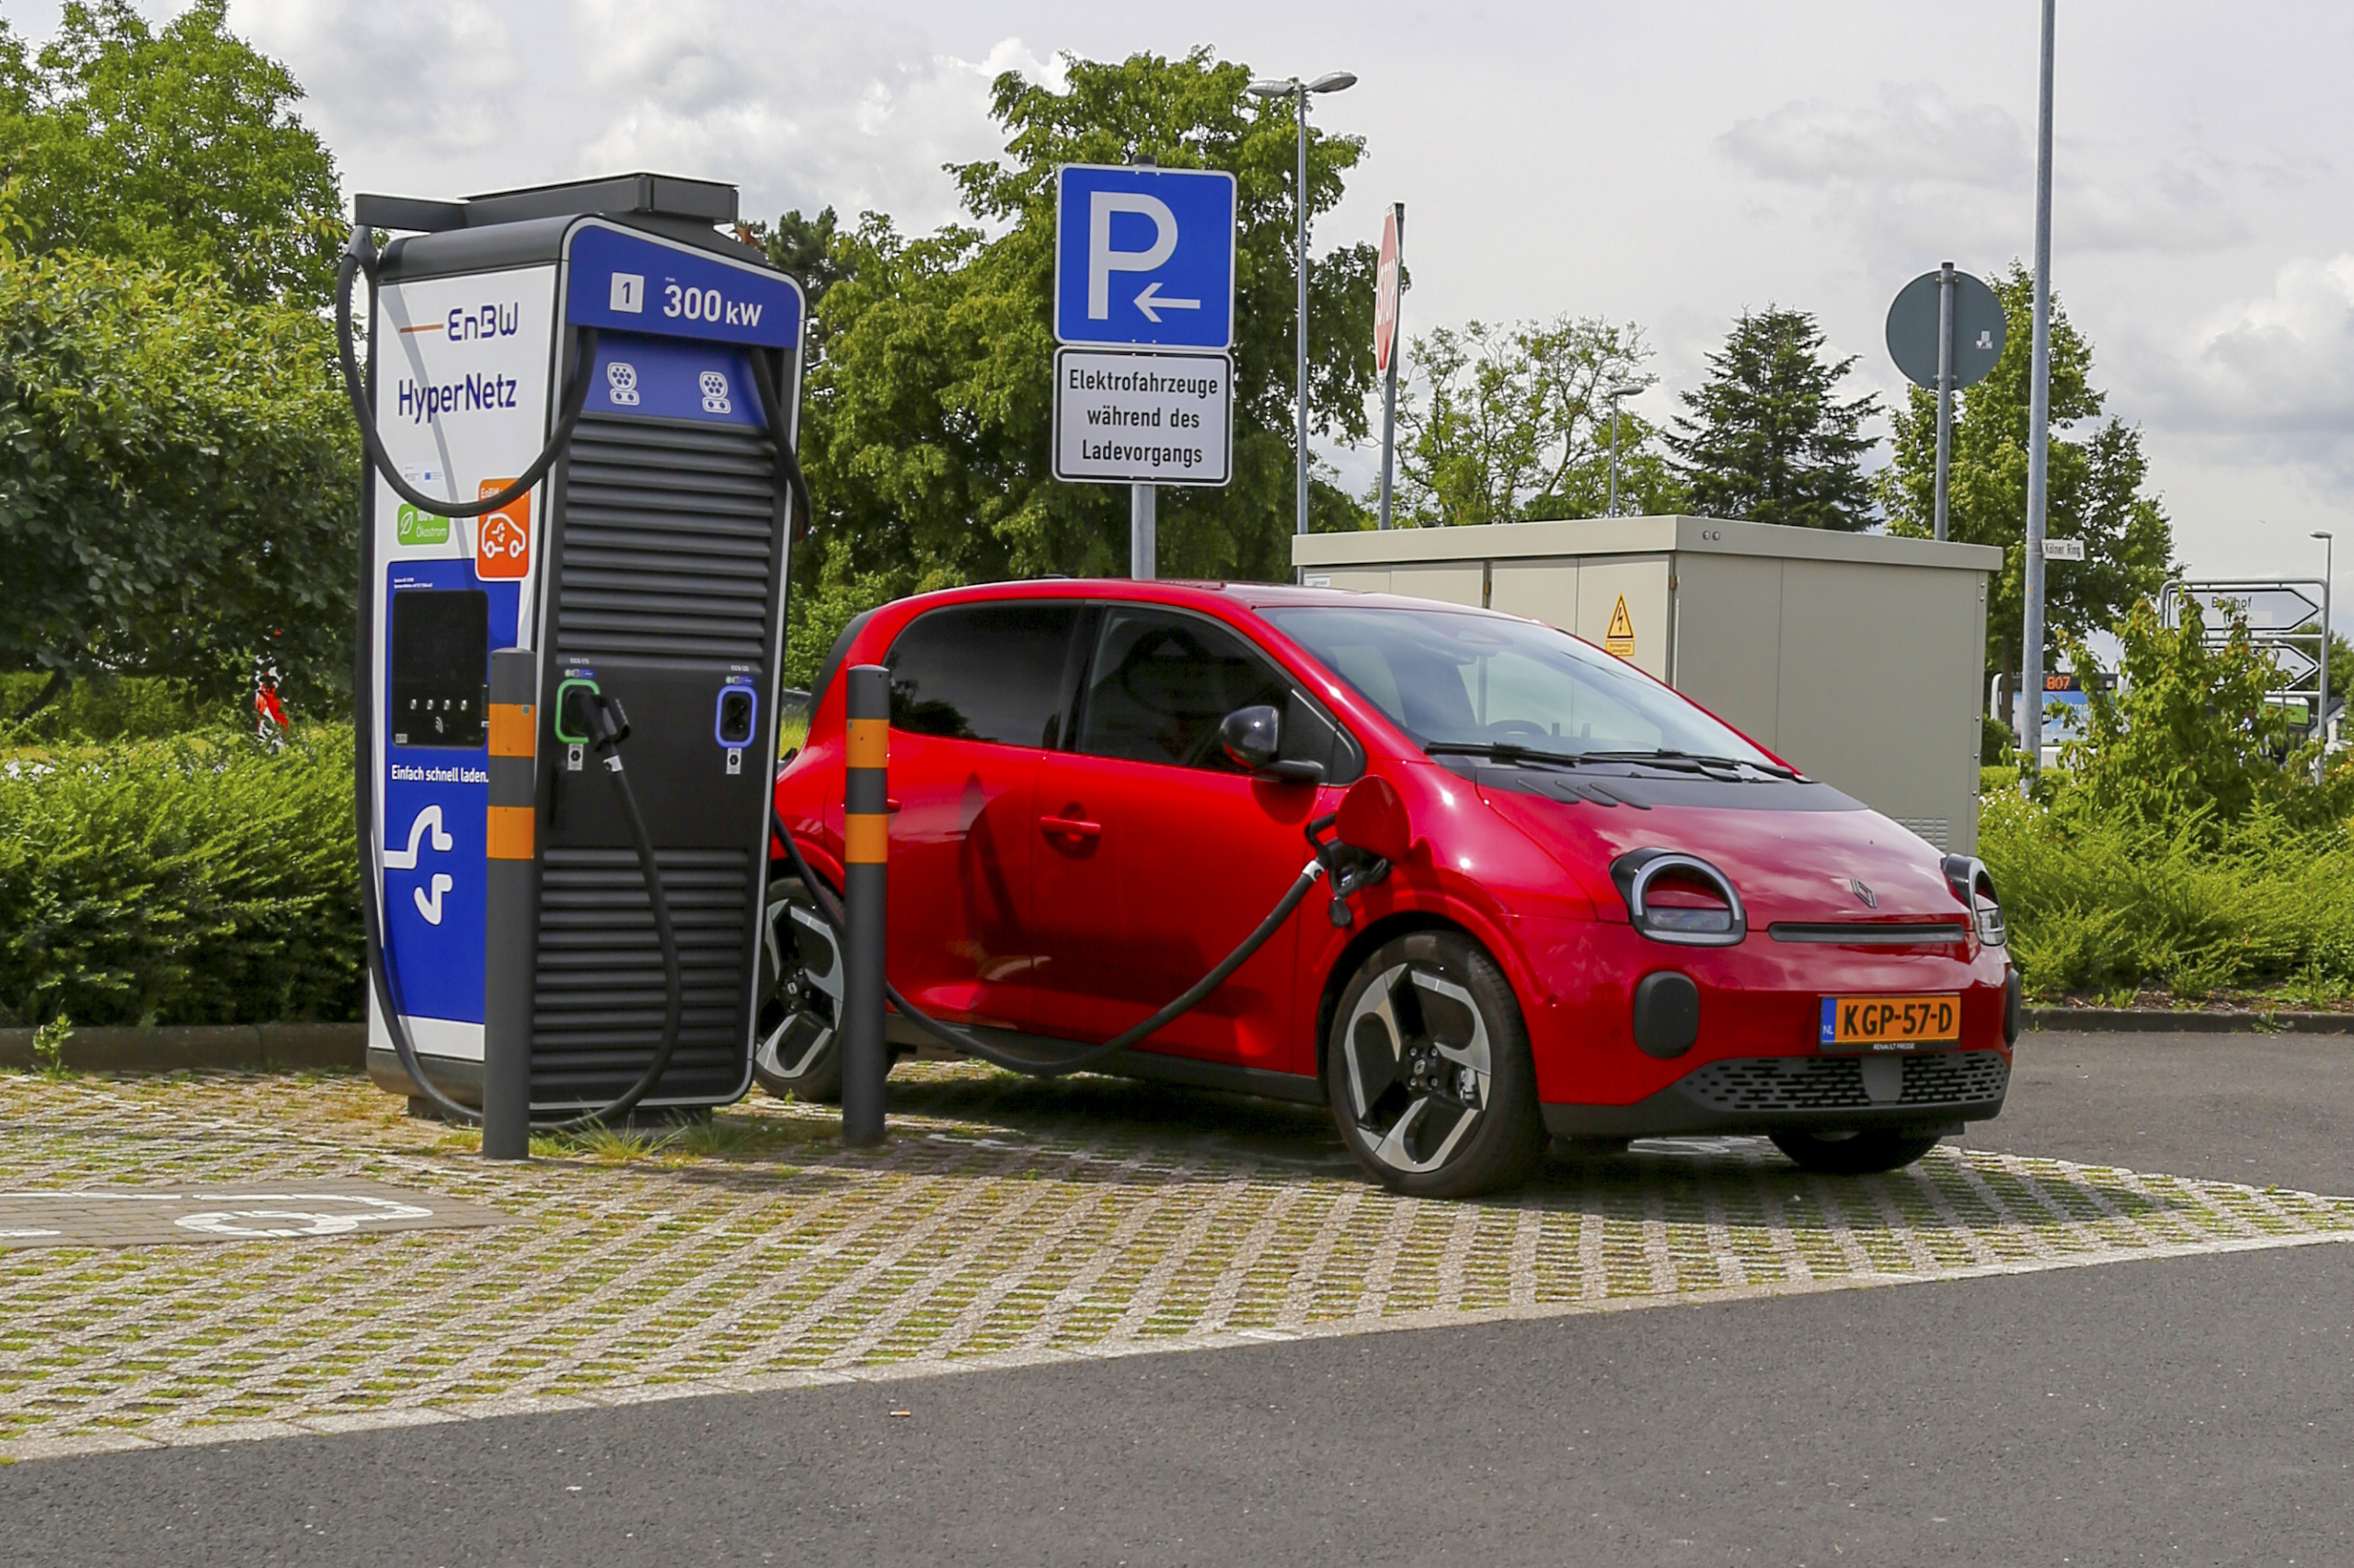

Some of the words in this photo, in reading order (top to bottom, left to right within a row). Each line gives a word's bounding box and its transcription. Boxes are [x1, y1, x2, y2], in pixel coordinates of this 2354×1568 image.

[1088, 191, 1178, 320] P
[622, 281, 631, 304] 1
[663, 284, 722, 323] 300
[725, 301, 763, 326] kW
[448, 302, 518, 341] EnBW
[398, 372, 517, 425] HyperNetz
[1069, 369, 1218, 399] Elektrofahrzeuge
[1086, 405, 1161, 427] während
[1170, 407, 1200, 429] des
[1082, 439, 1203, 468] Ladevorgangs
[2046, 676, 2071, 690] 807
[391, 764, 424, 781] Einfach
[425, 766, 459, 783] schnell
[460, 767, 489, 784] laden.
[1822, 1024, 1834, 1035] NL
[1843, 1002, 1953, 1036] KGP-57-D
